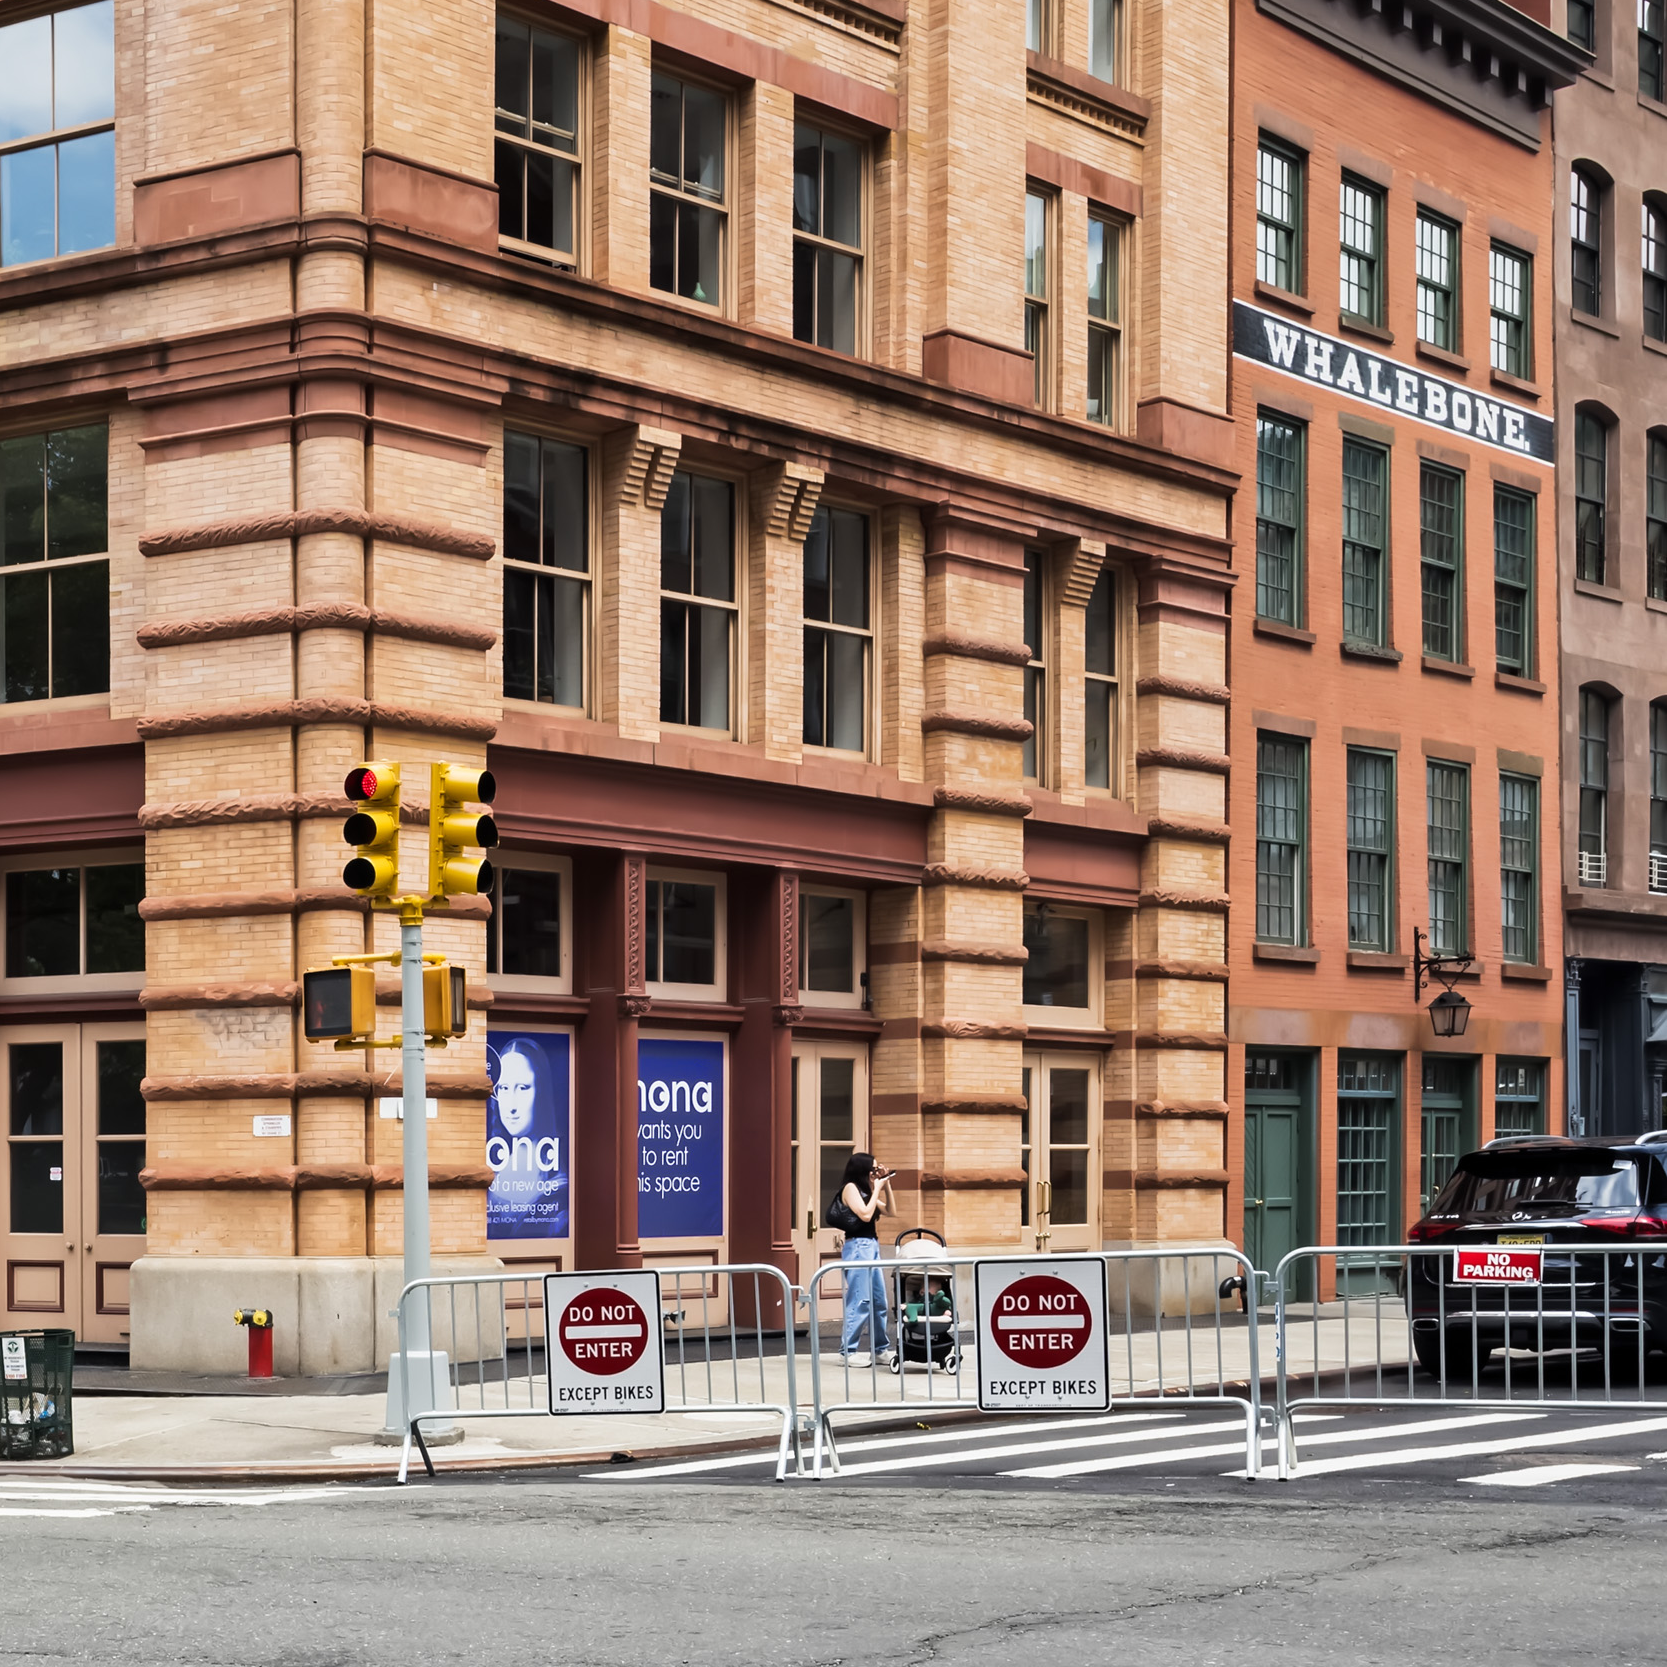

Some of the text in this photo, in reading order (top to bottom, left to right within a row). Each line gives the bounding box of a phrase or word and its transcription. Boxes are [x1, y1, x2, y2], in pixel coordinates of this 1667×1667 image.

[637, 1120, 702, 1147] ants you
[642, 1146, 688, 1166] to rent
[502, 1181, 510, 1192] a
[512, 1181, 534, 1192] new
[536, 1180, 559, 1196] age
[654, 1176, 700, 1200] space
[511, 1200, 536, 1216] leasing
[537, 1202, 559, 1215] agent
[1486, 1253, 1511, 1265] NO
[1463, 1264, 1534, 1279] PARKING
[1002, 1294, 1078, 1311] DO NOT
[569, 1305, 635, 1322] DO NOT
[1009, 1333, 1074, 1350] ENTER
[575, 1342, 633, 1358] ENTER
[559, 1385, 654, 1401] EXCEPT BIKES
[990, 1380, 1097, 1395] EXCEPT BIKES
